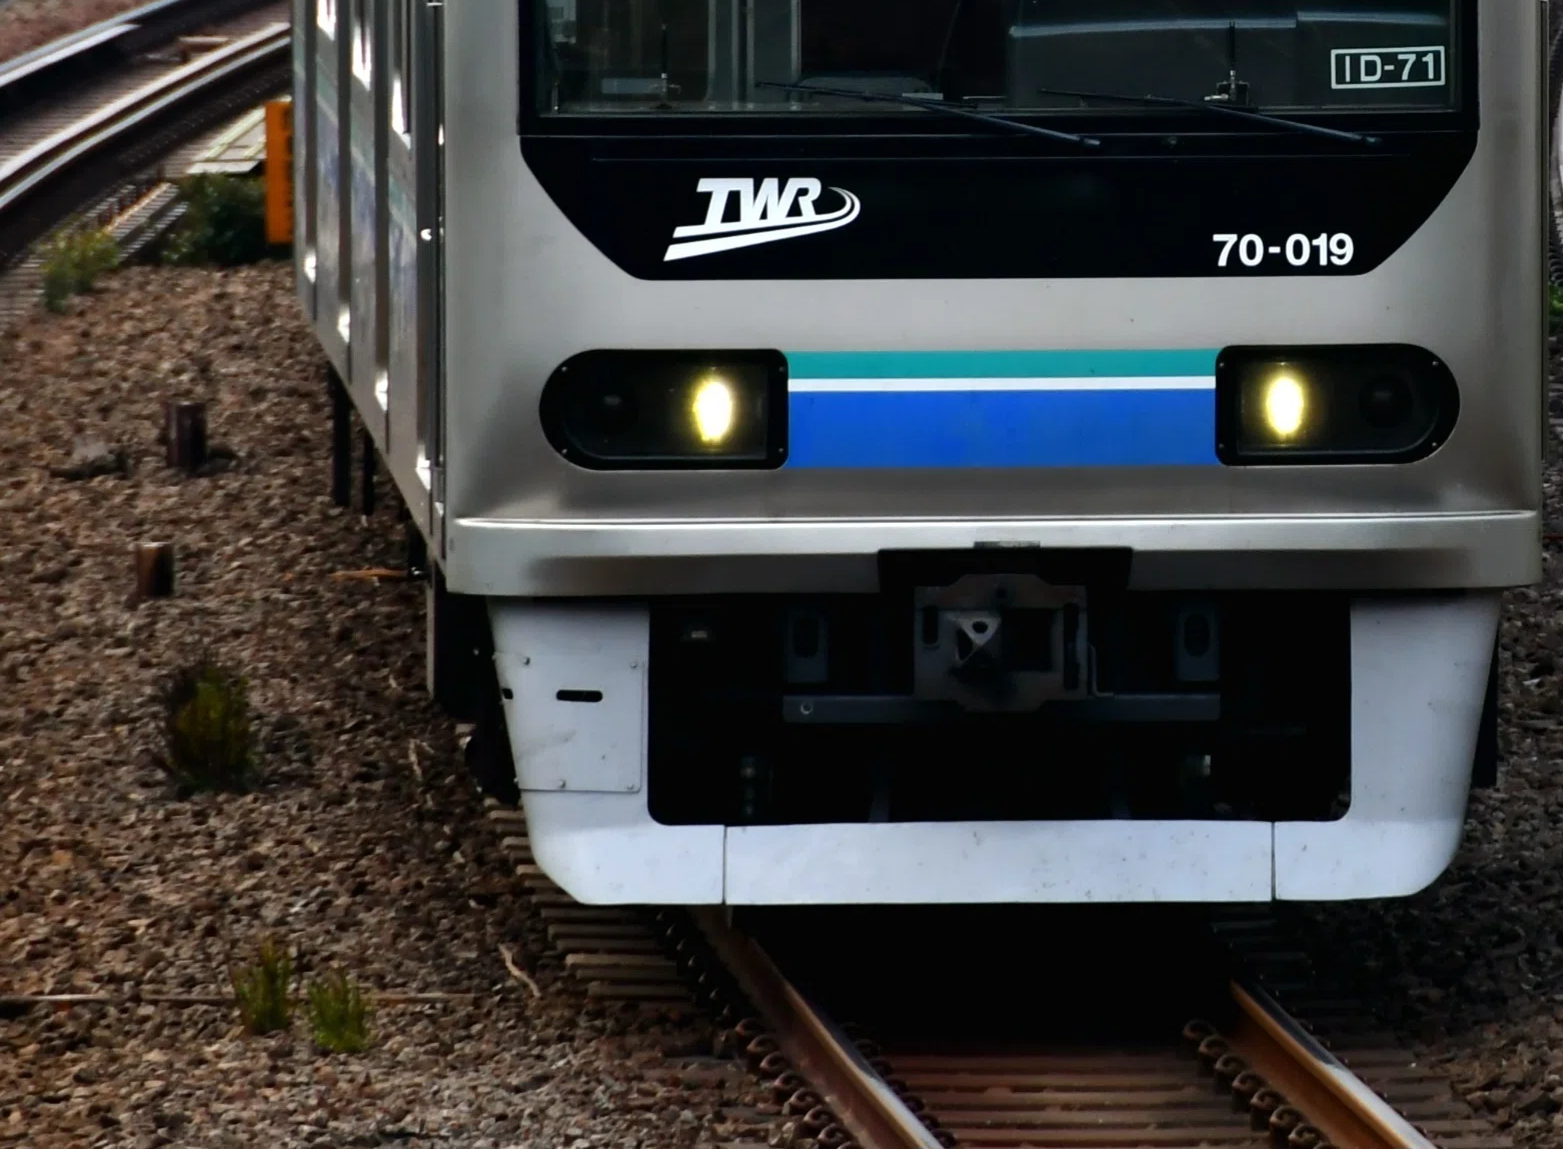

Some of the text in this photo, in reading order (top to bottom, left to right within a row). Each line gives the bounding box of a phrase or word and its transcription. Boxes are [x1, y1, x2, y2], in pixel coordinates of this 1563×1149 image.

[1344, 52, 1435, 83] ID-71
[696, 177, 822, 225] TWR
[1212, 232, 1355, 267] 70-019
